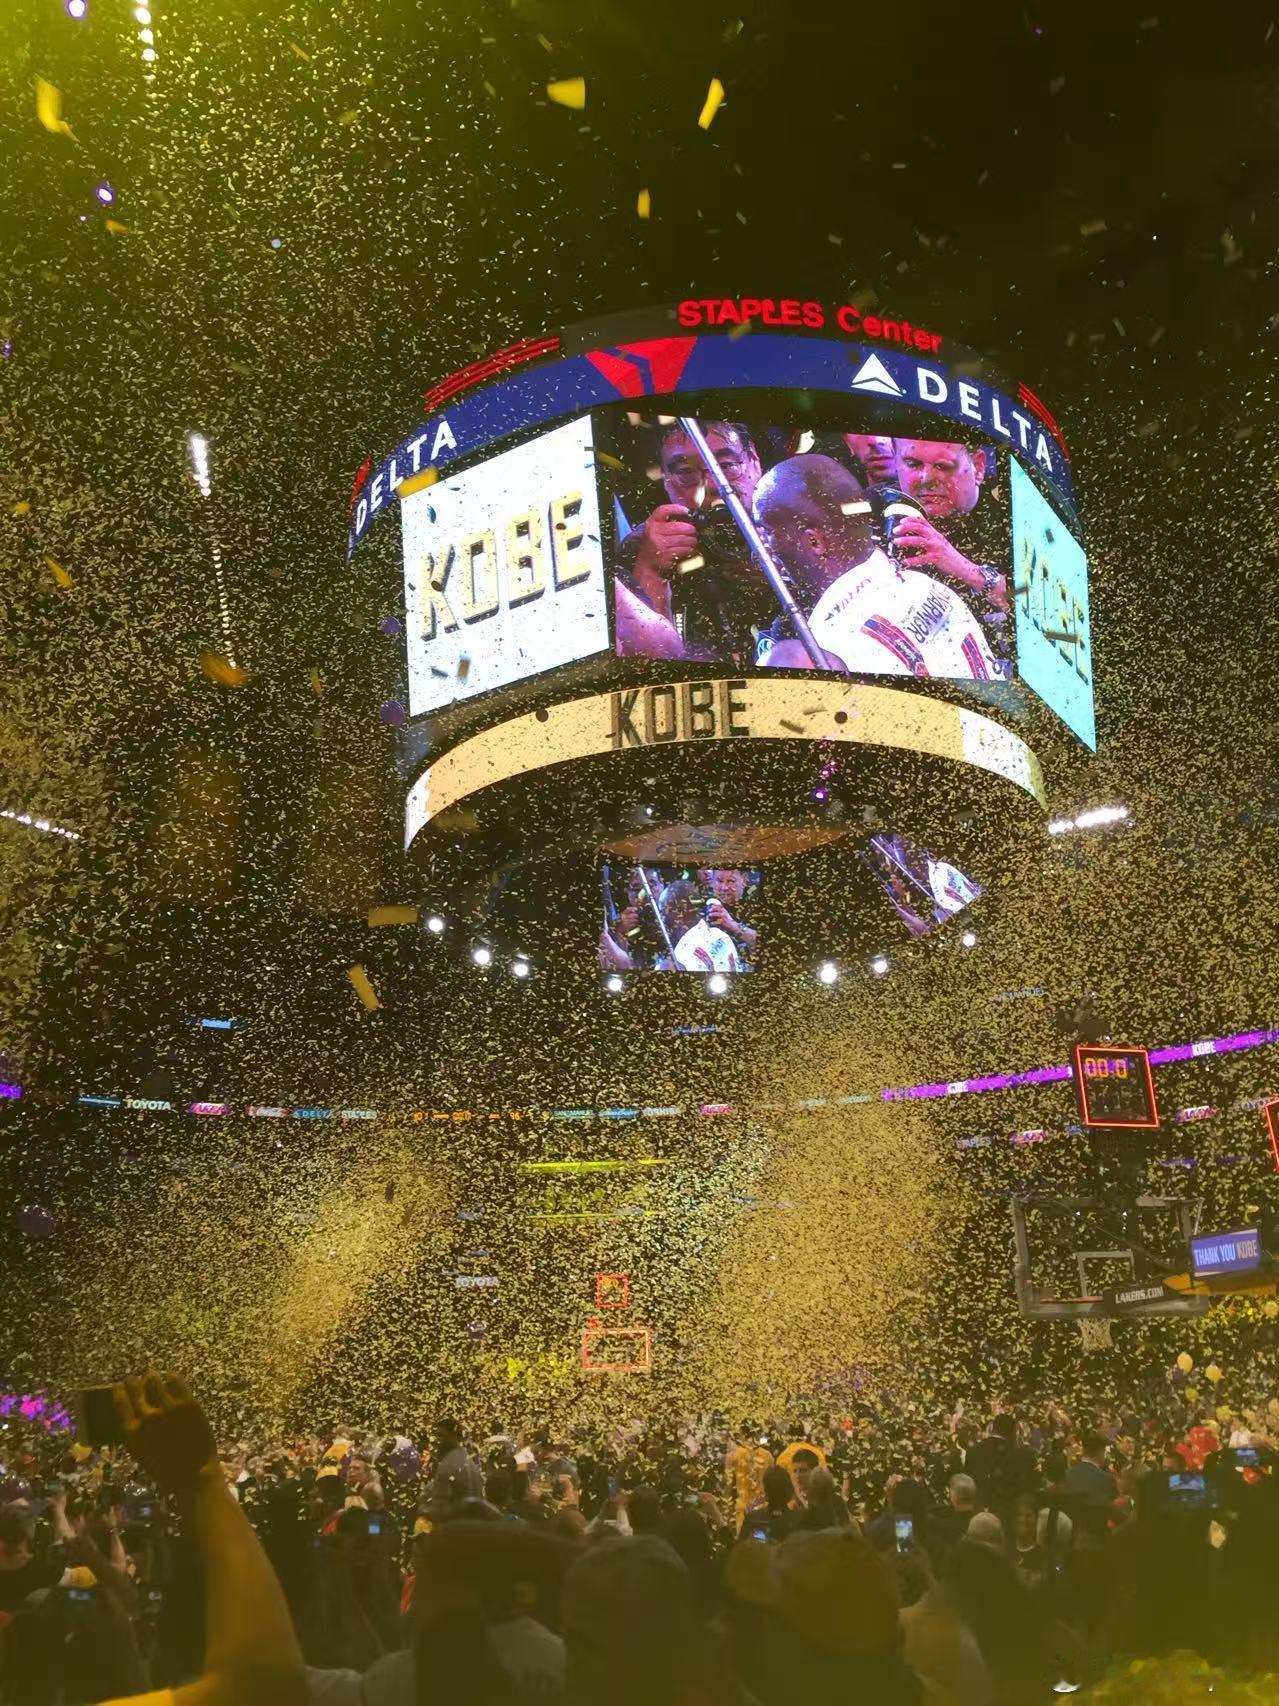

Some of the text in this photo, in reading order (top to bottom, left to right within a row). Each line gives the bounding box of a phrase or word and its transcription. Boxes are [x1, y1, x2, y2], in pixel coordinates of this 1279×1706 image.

[678, 298, 944, 354] STAPLES Center
[917, 366, 1054, 473] DELTA
[354, 419, 458, 537] DELTA
[420, 490, 592, 643] KOBE
[611, 680, 749, 751] KOBE
[126, 1099, 171, 1111] TOYOTA
[1193, 1239, 1258, 1267] THANK YOU KOBE
